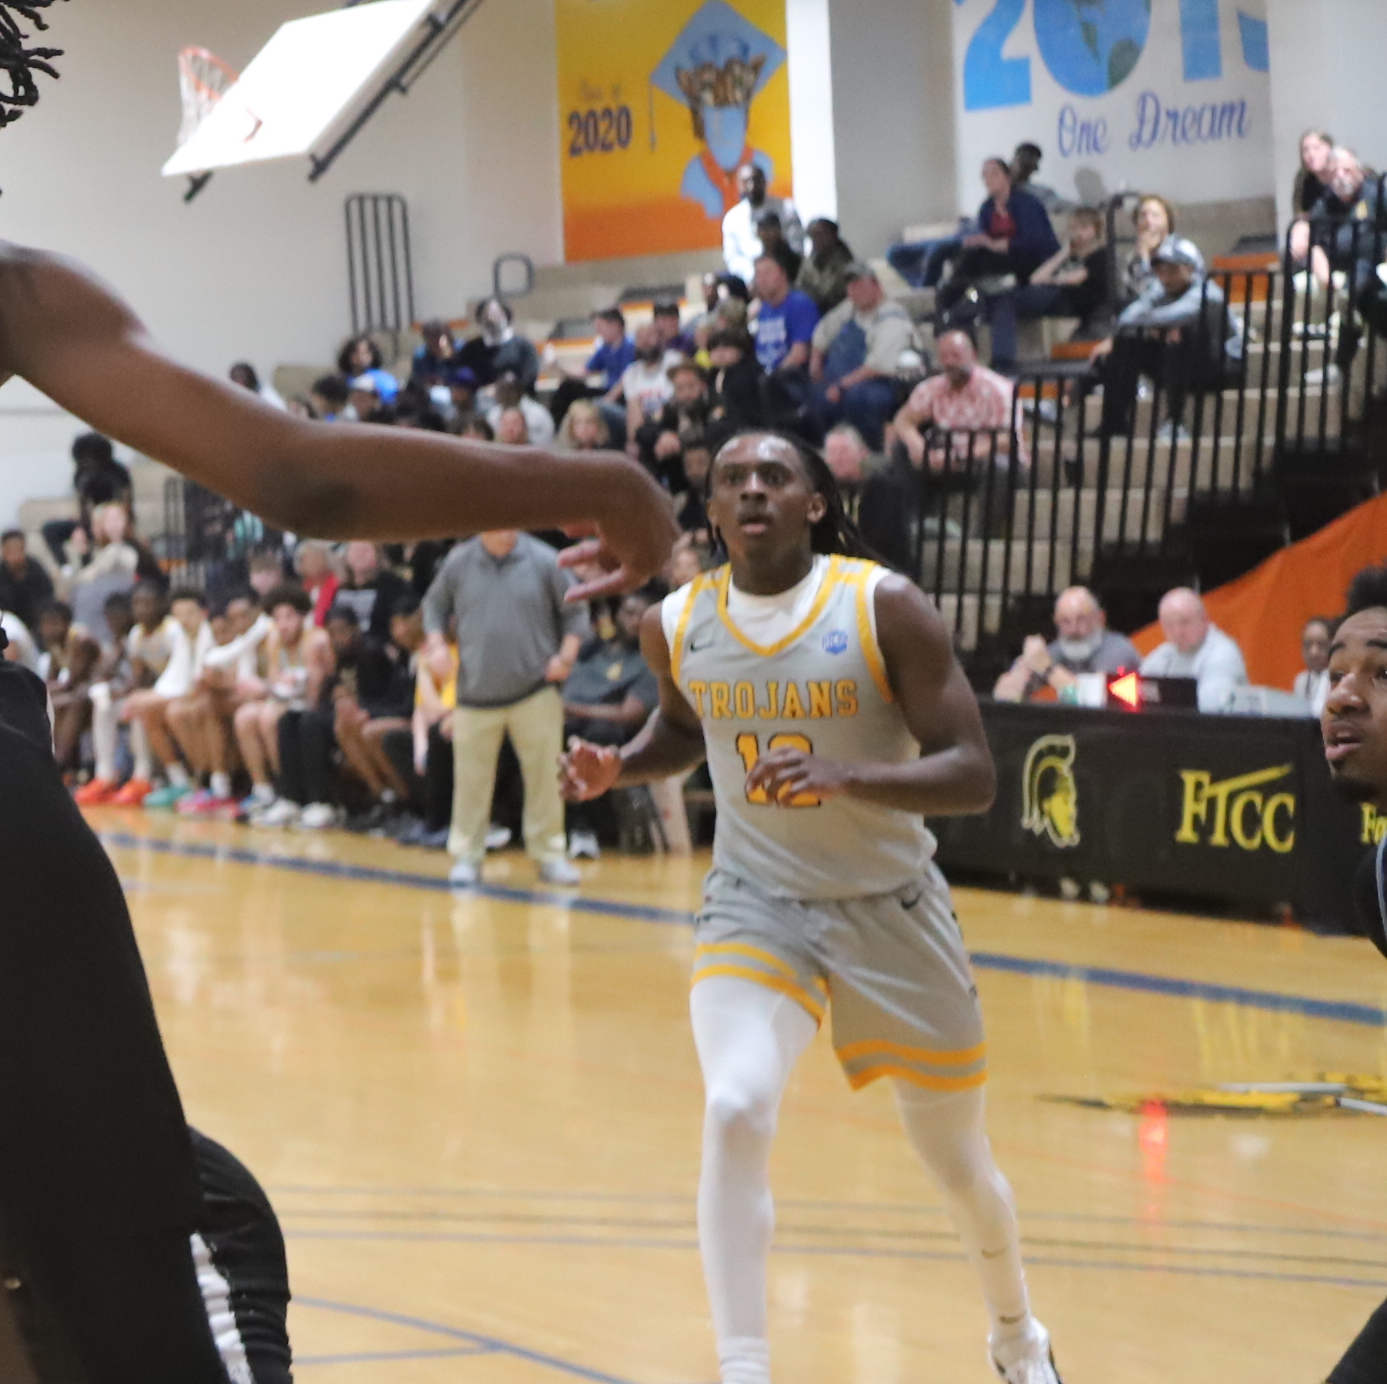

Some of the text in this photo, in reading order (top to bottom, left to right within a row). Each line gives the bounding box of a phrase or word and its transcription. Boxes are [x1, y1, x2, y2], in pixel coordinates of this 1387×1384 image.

[568, 105, 633, 157] 2020
[1058, 90, 1249, 157] One Dream
[688, 678, 860, 720] TROJANS
[1175, 762, 1296, 854] FTCC
